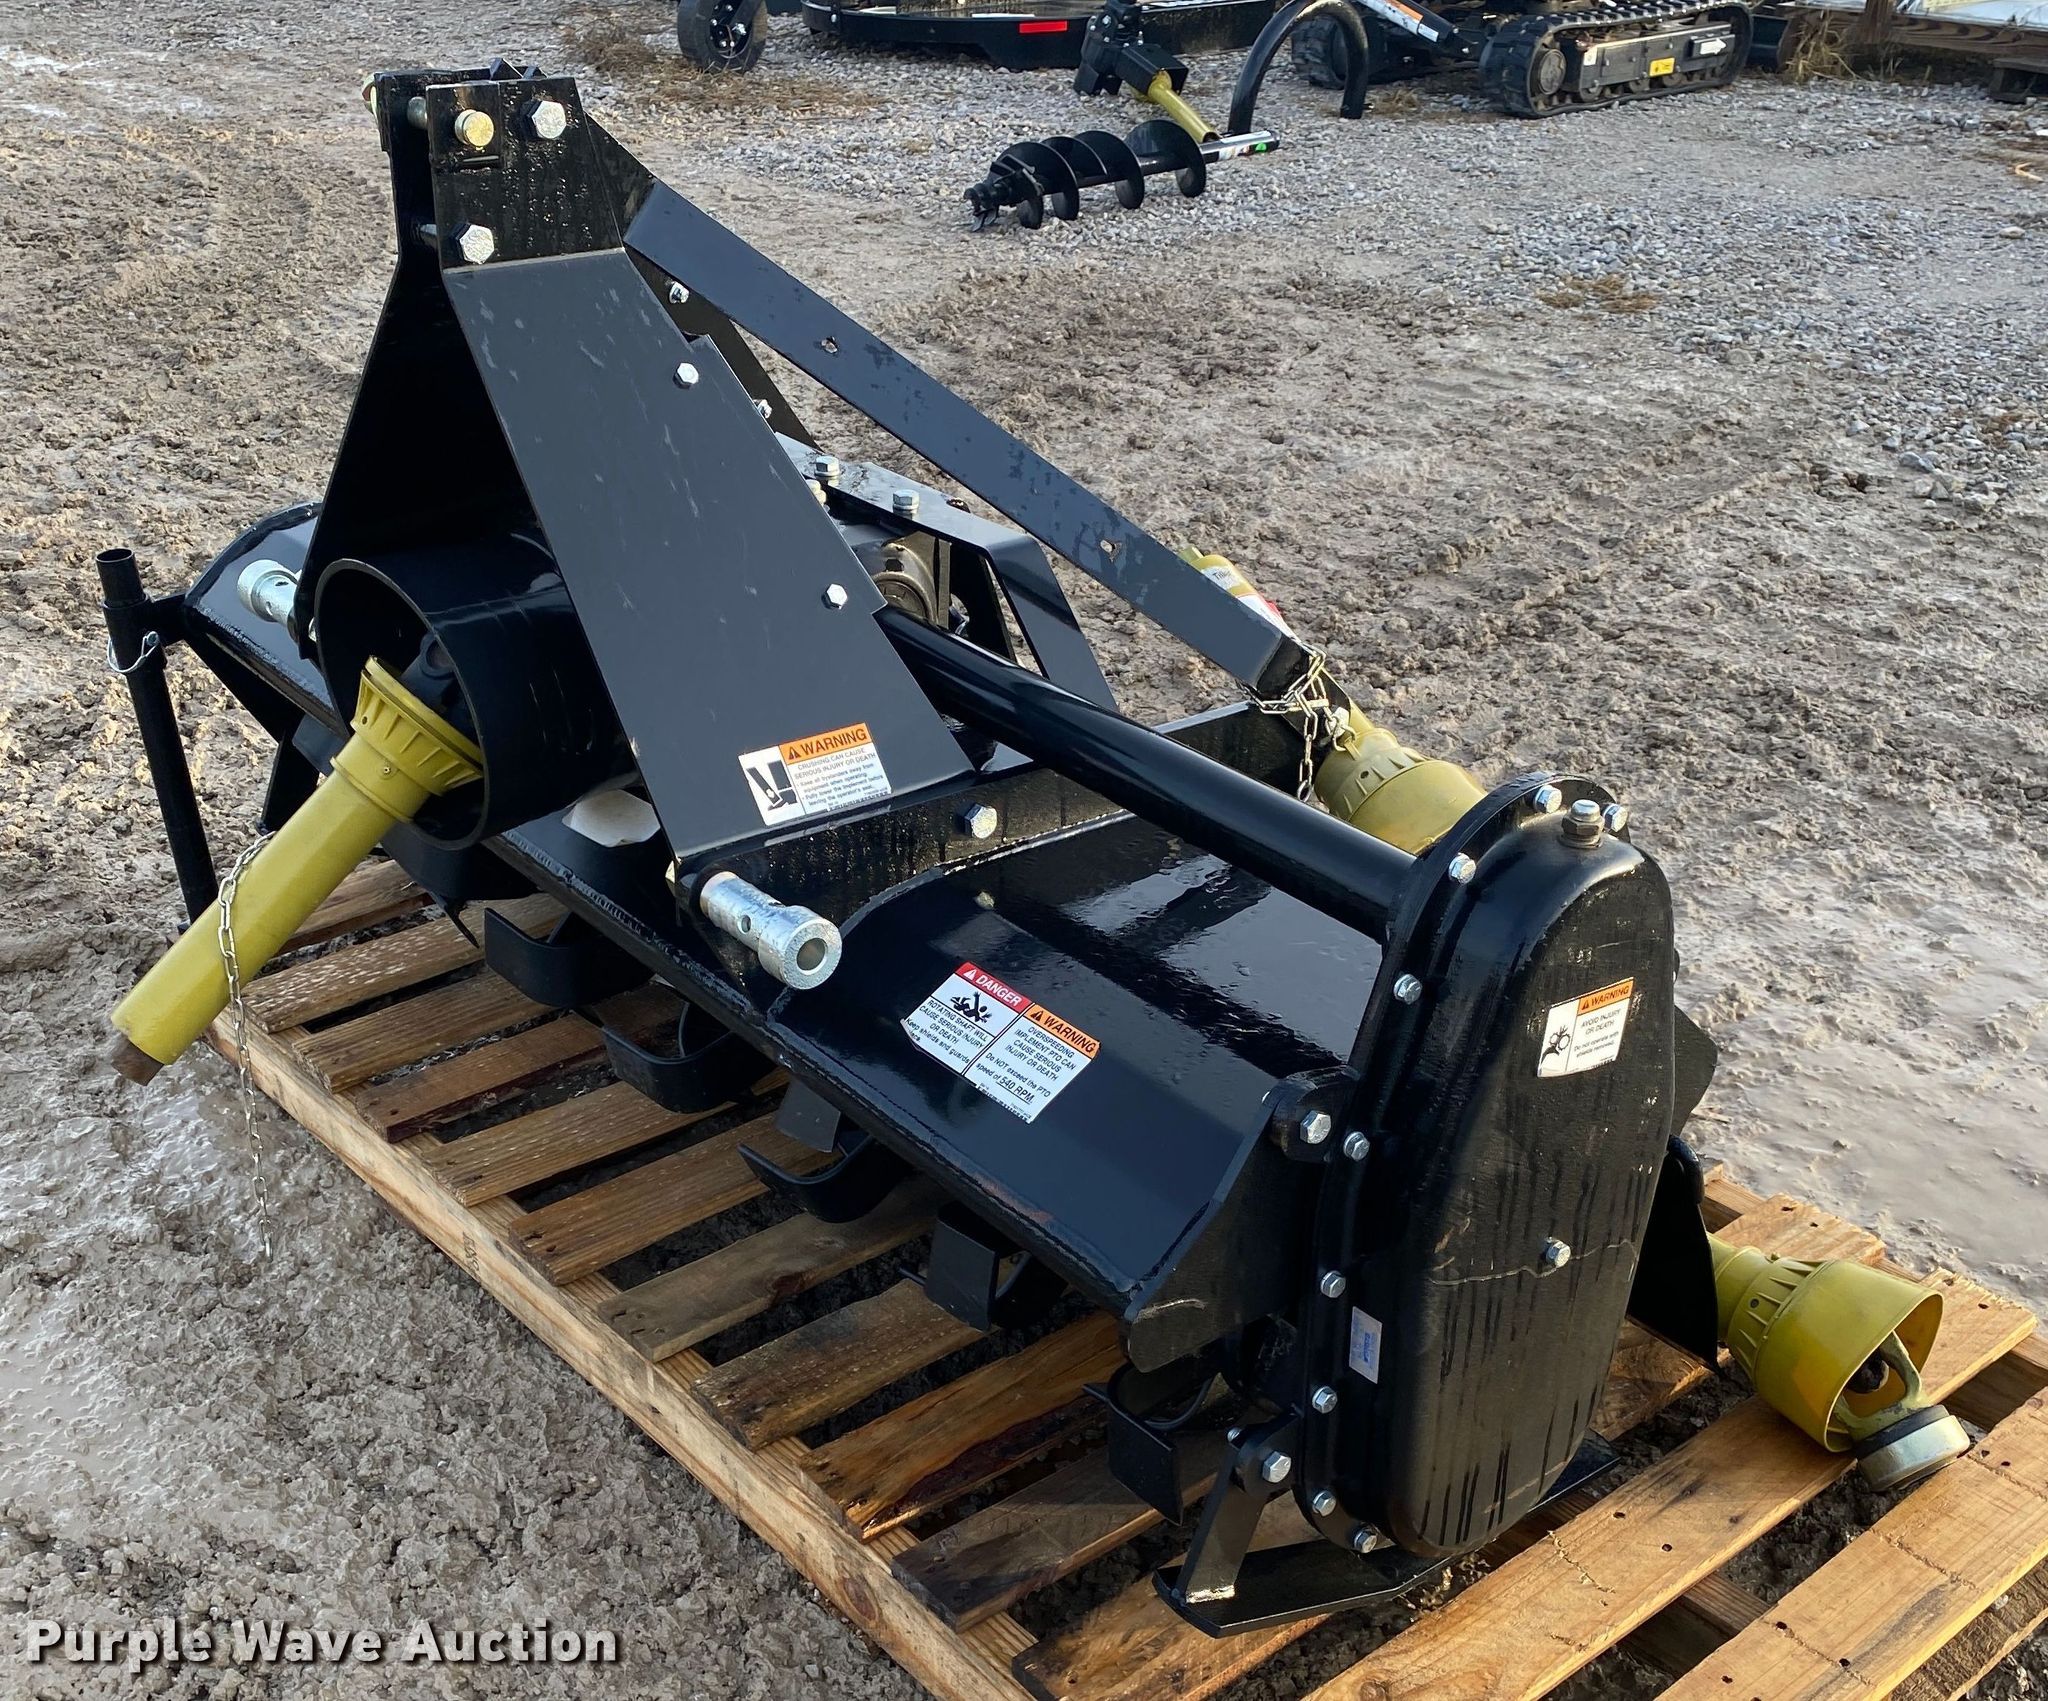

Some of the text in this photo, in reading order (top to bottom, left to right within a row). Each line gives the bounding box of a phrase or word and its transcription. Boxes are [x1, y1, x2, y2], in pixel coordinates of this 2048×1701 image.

[801, 728, 867, 755] WARNING
[794, 768, 822, 779] SERIOUS
[822, 761, 843, 771] INJURY
[855, 753, 876, 763] DEATH
[798, 757, 830, 770] CRUSHING
[845, 748, 865, 757] CAUSE
[976, 975, 1022, 1006] DANGER
[1591, 986, 1629, 1006] WARNING
[919, 1006, 984, 1048] CAUSE SERIOUS INJURY
[927, 998, 988, 1042] ROTATING SHAFT WILL
[930, 1023, 959, 1044] OR DEATH
[1044, 1015, 1097, 1054] WARNING
[1581, 1017, 1599, 1027] AVOID
[1595, 1020, 1614, 1031] DEATH
[906, 1018, 970, 1063] Keep shields and guards
[1014, 1040, 1061, 1072] CAUSE SERIOUS
[1015, 1029, 1076, 1070] IMPLEMENT PTO CAN
[1028, 1027, 1074, 1058] OVERSPEEDING
[976, 1063, 995, 1076] speed
[1000, 1076, 1016, 1091] 540
[986, 1053, 1051, 1097] Do NOT exceed the PTO
[1005, 1045, 1058, 1081] INJURY OR DEATH
